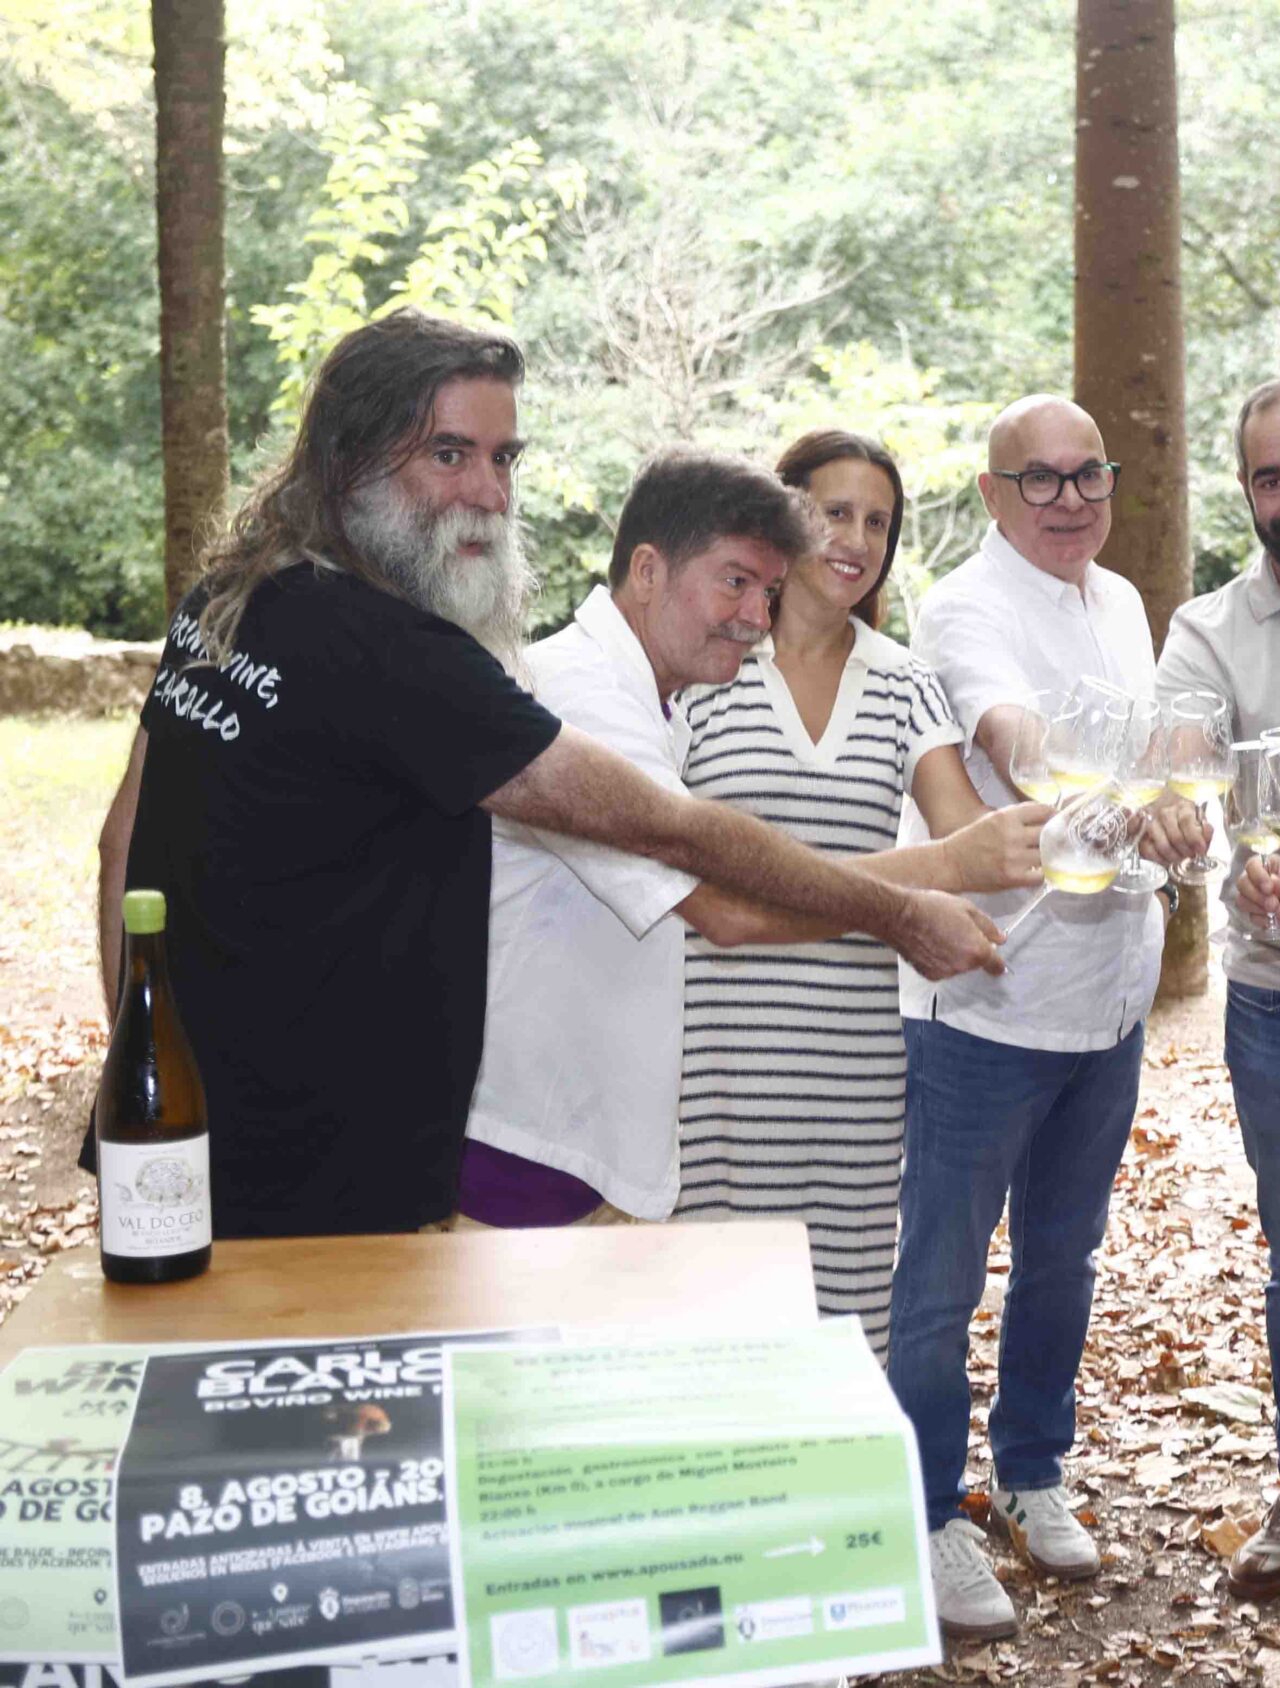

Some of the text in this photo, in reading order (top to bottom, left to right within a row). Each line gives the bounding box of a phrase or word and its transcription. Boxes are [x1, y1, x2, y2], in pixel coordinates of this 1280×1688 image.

[118, 1215, 145, 1230] VAL
[150, 1215, 176, 1230] DO
[343, 1385, 423, 1402] WINE
[608, 1473, 651, 1486] cargo
[678, 1463, 728, 1479] Miguel
[179, 1484, 210, 1511] 8.
[221, 1466, 366, 1507] AGOSTO
[18, 1500, 65, 1522] DE
[139, 1503, 243, 1543] PAZO
[251, 1496, 297, 1527] DE
[845, 1530, 883, 1549] 25€
[485, 1552, 744, 1596] Entradas en www.apousada.eu
